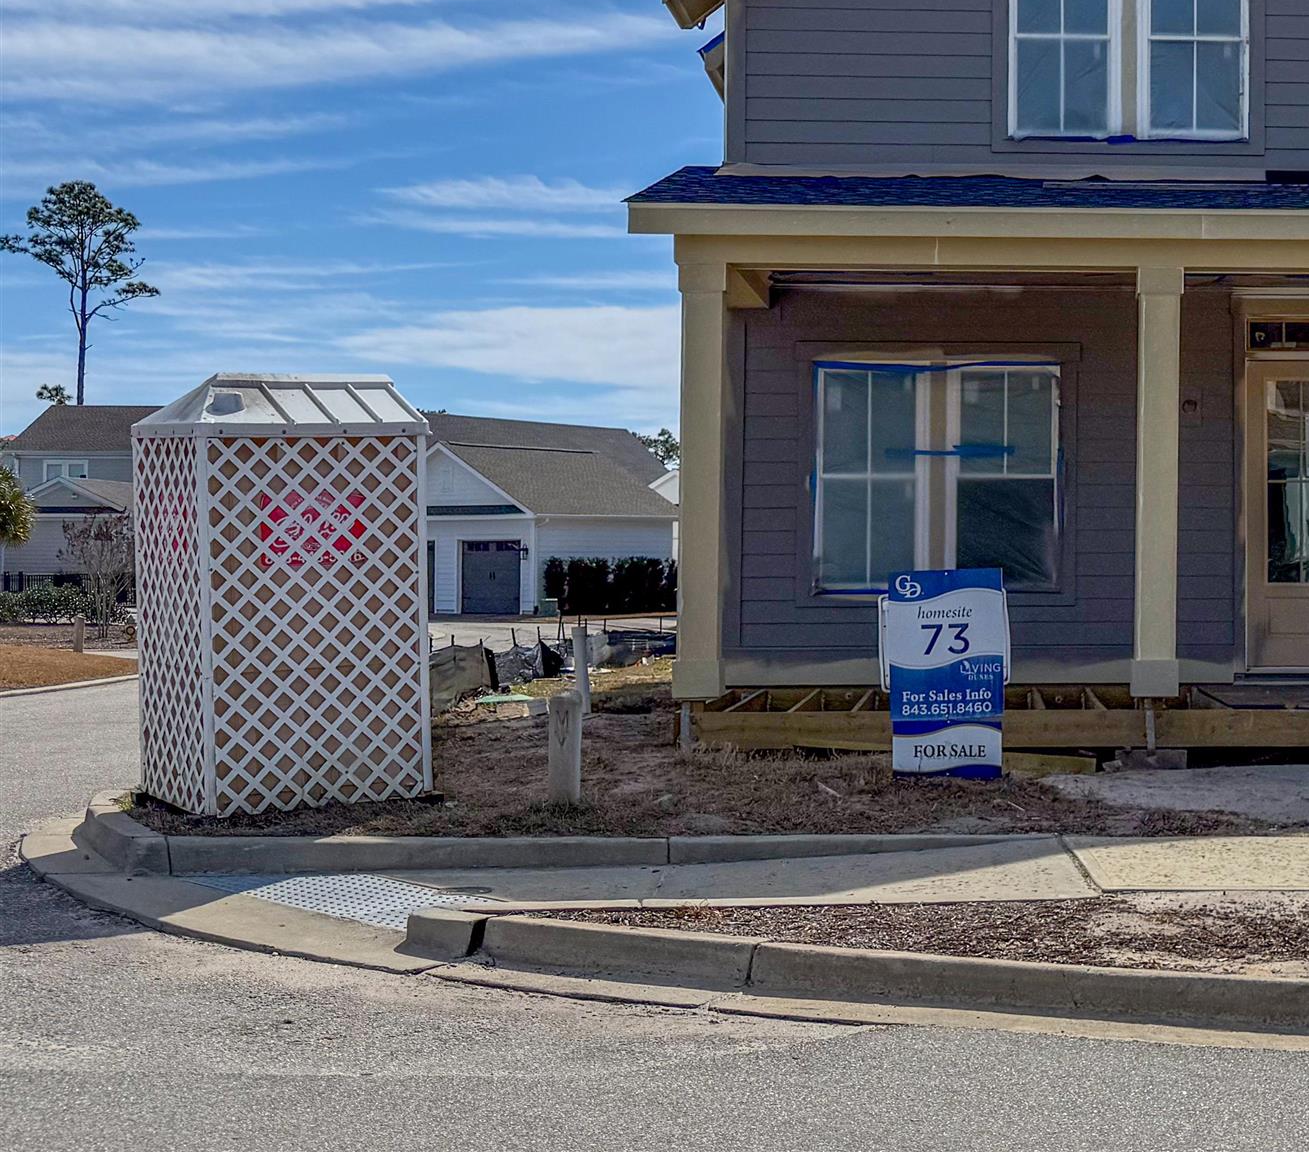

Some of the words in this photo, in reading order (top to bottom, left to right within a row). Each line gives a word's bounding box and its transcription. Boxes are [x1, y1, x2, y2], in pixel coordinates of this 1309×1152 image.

[917, 606, 973, 619] homesite
[921, 623, 970, 655] 73
[902, 691, 926, 702] For
[929, 689, 963, 701] Sales
[965, 688, 992, 700] Info
[902, 701, 992, 715] 843.651.8460
[913, 745, 947, 758] FOR
[950, 744, 987, 758] SALE
